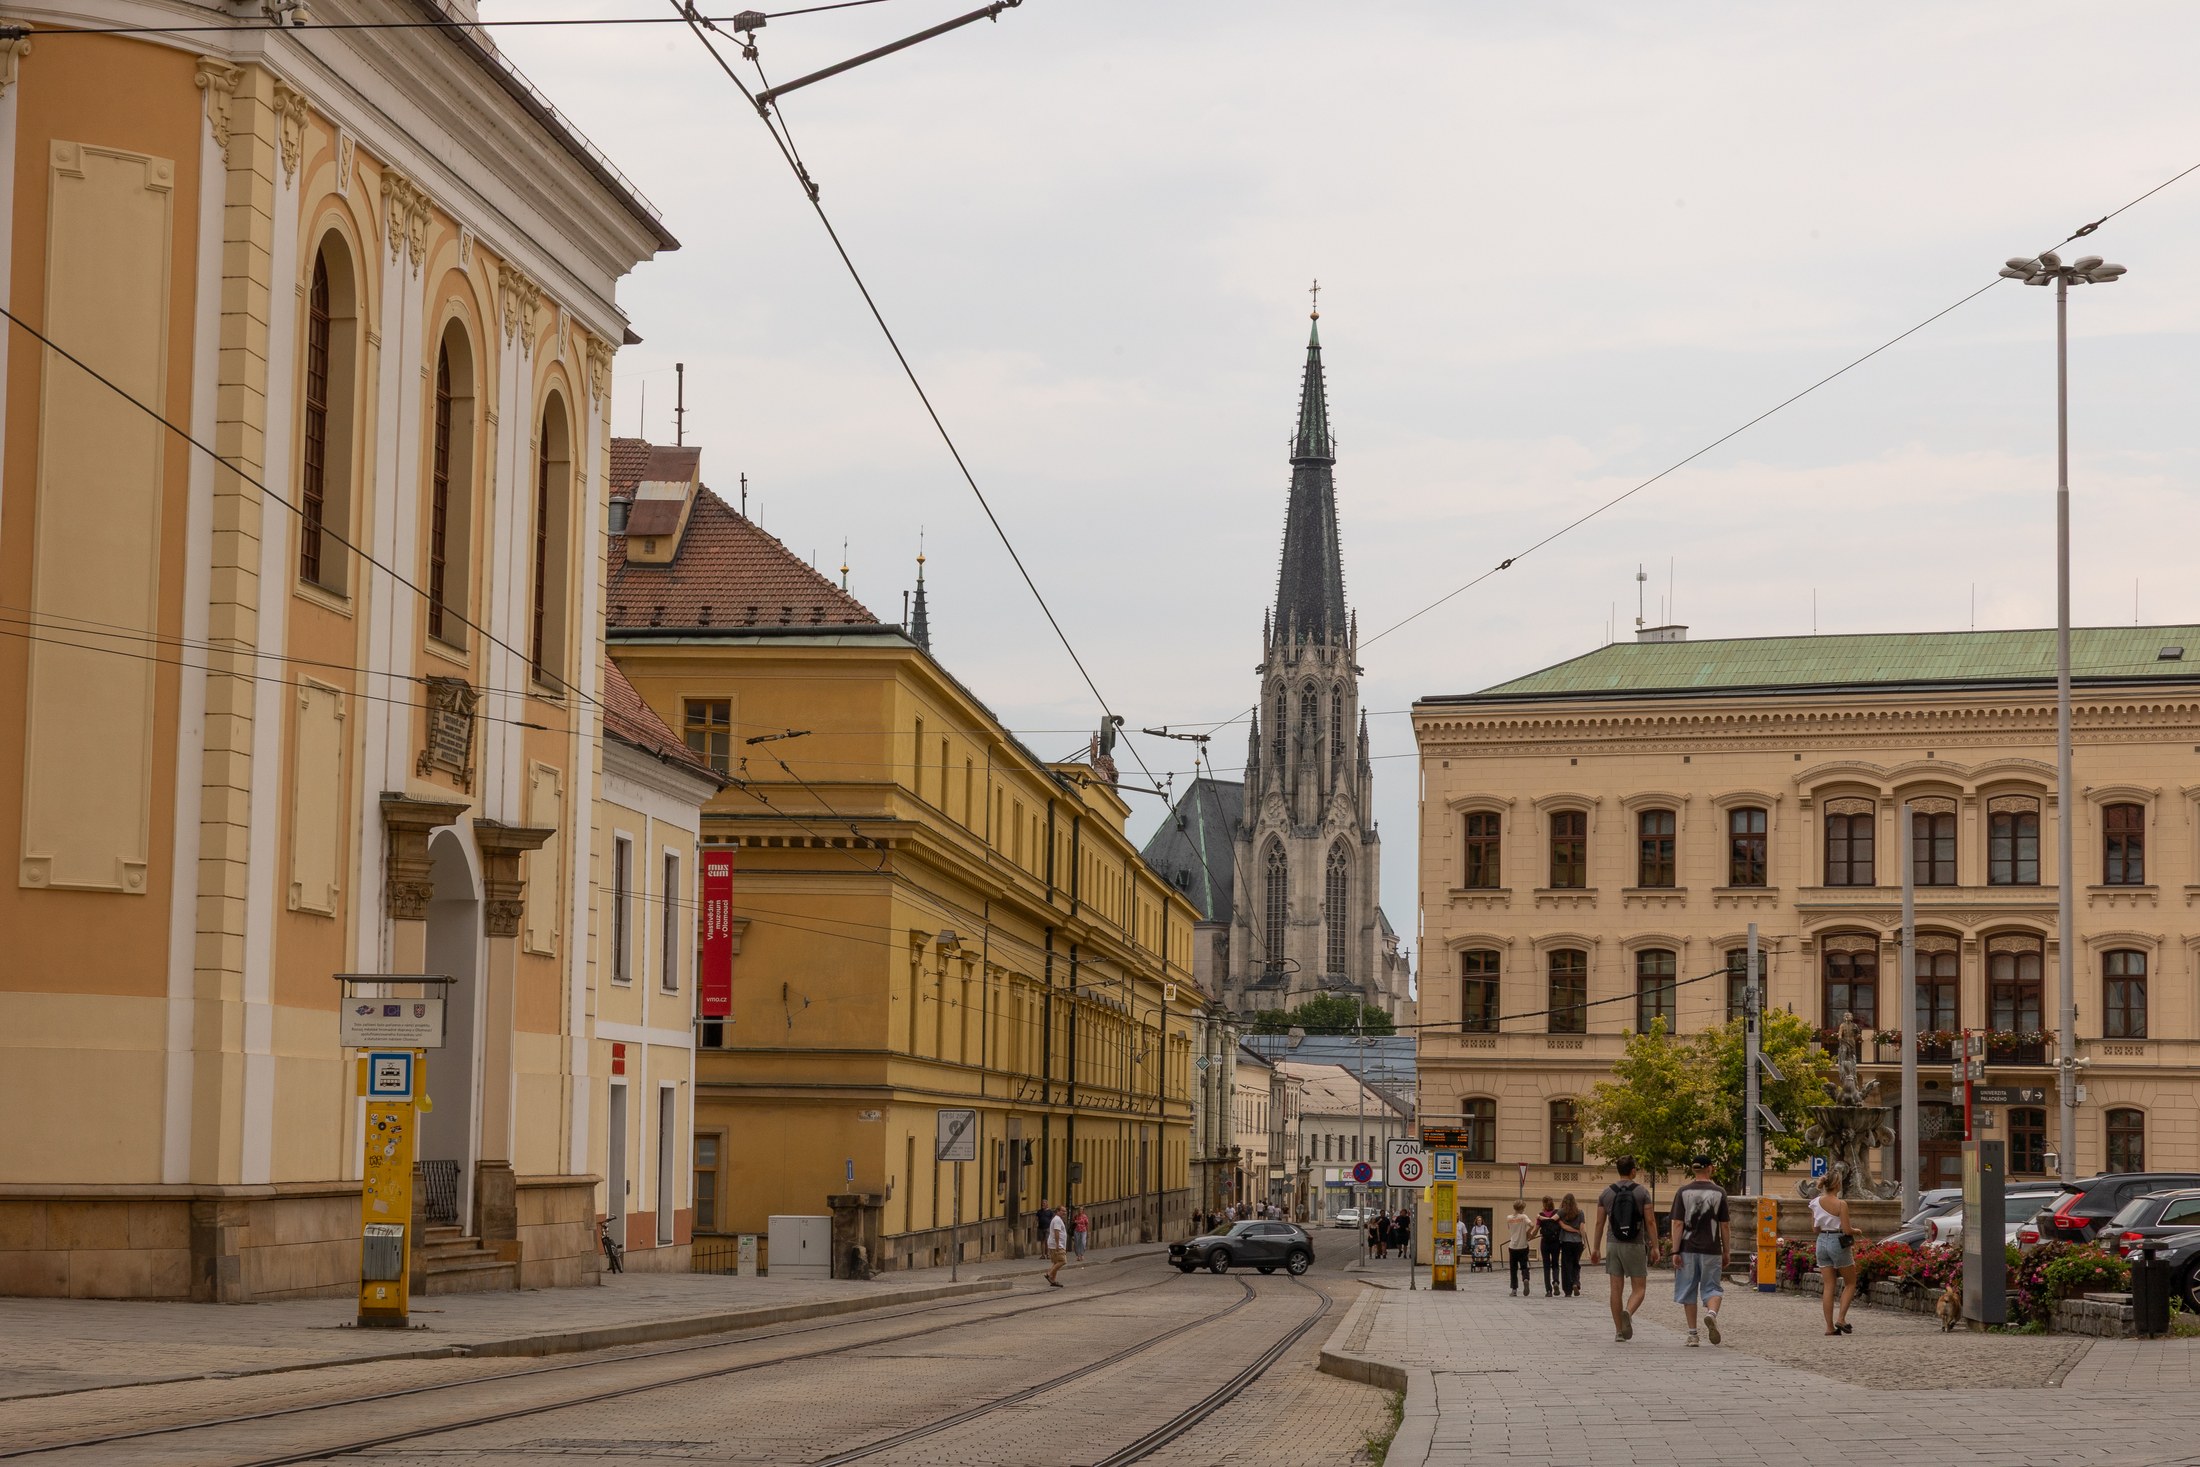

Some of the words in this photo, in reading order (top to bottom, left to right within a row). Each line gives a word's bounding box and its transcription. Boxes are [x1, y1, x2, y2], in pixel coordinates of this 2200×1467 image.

[1396, 1142, 1426, 1154] ZÓNA
[1404, 1164, 1418, 1175] 30
[1814, 1158, 1824, 1171] P
